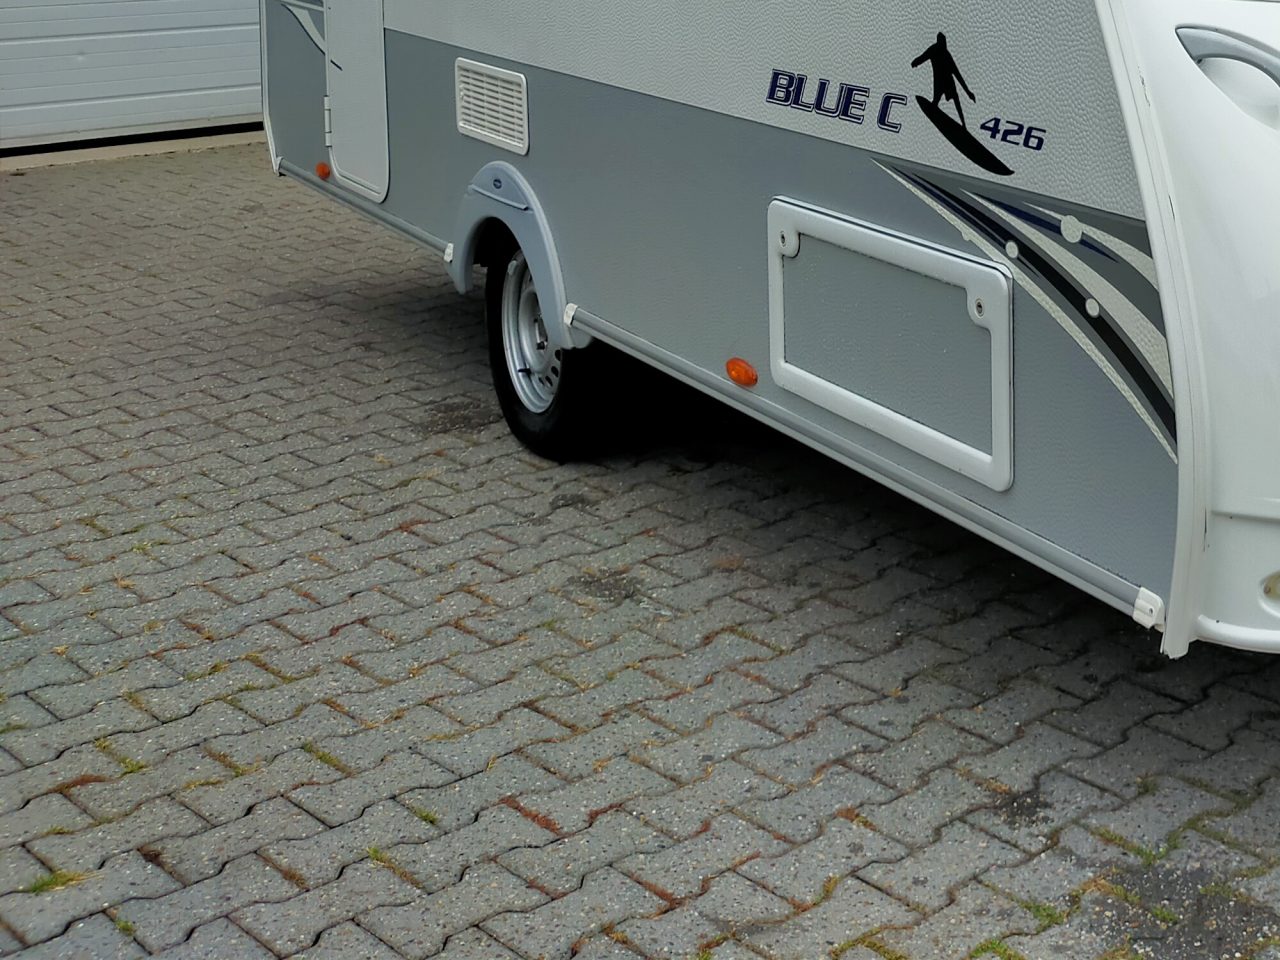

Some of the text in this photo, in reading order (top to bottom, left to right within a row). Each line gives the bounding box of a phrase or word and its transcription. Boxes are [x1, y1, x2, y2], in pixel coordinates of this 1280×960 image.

[765, 68, 1047, 151] BLUE C 426
